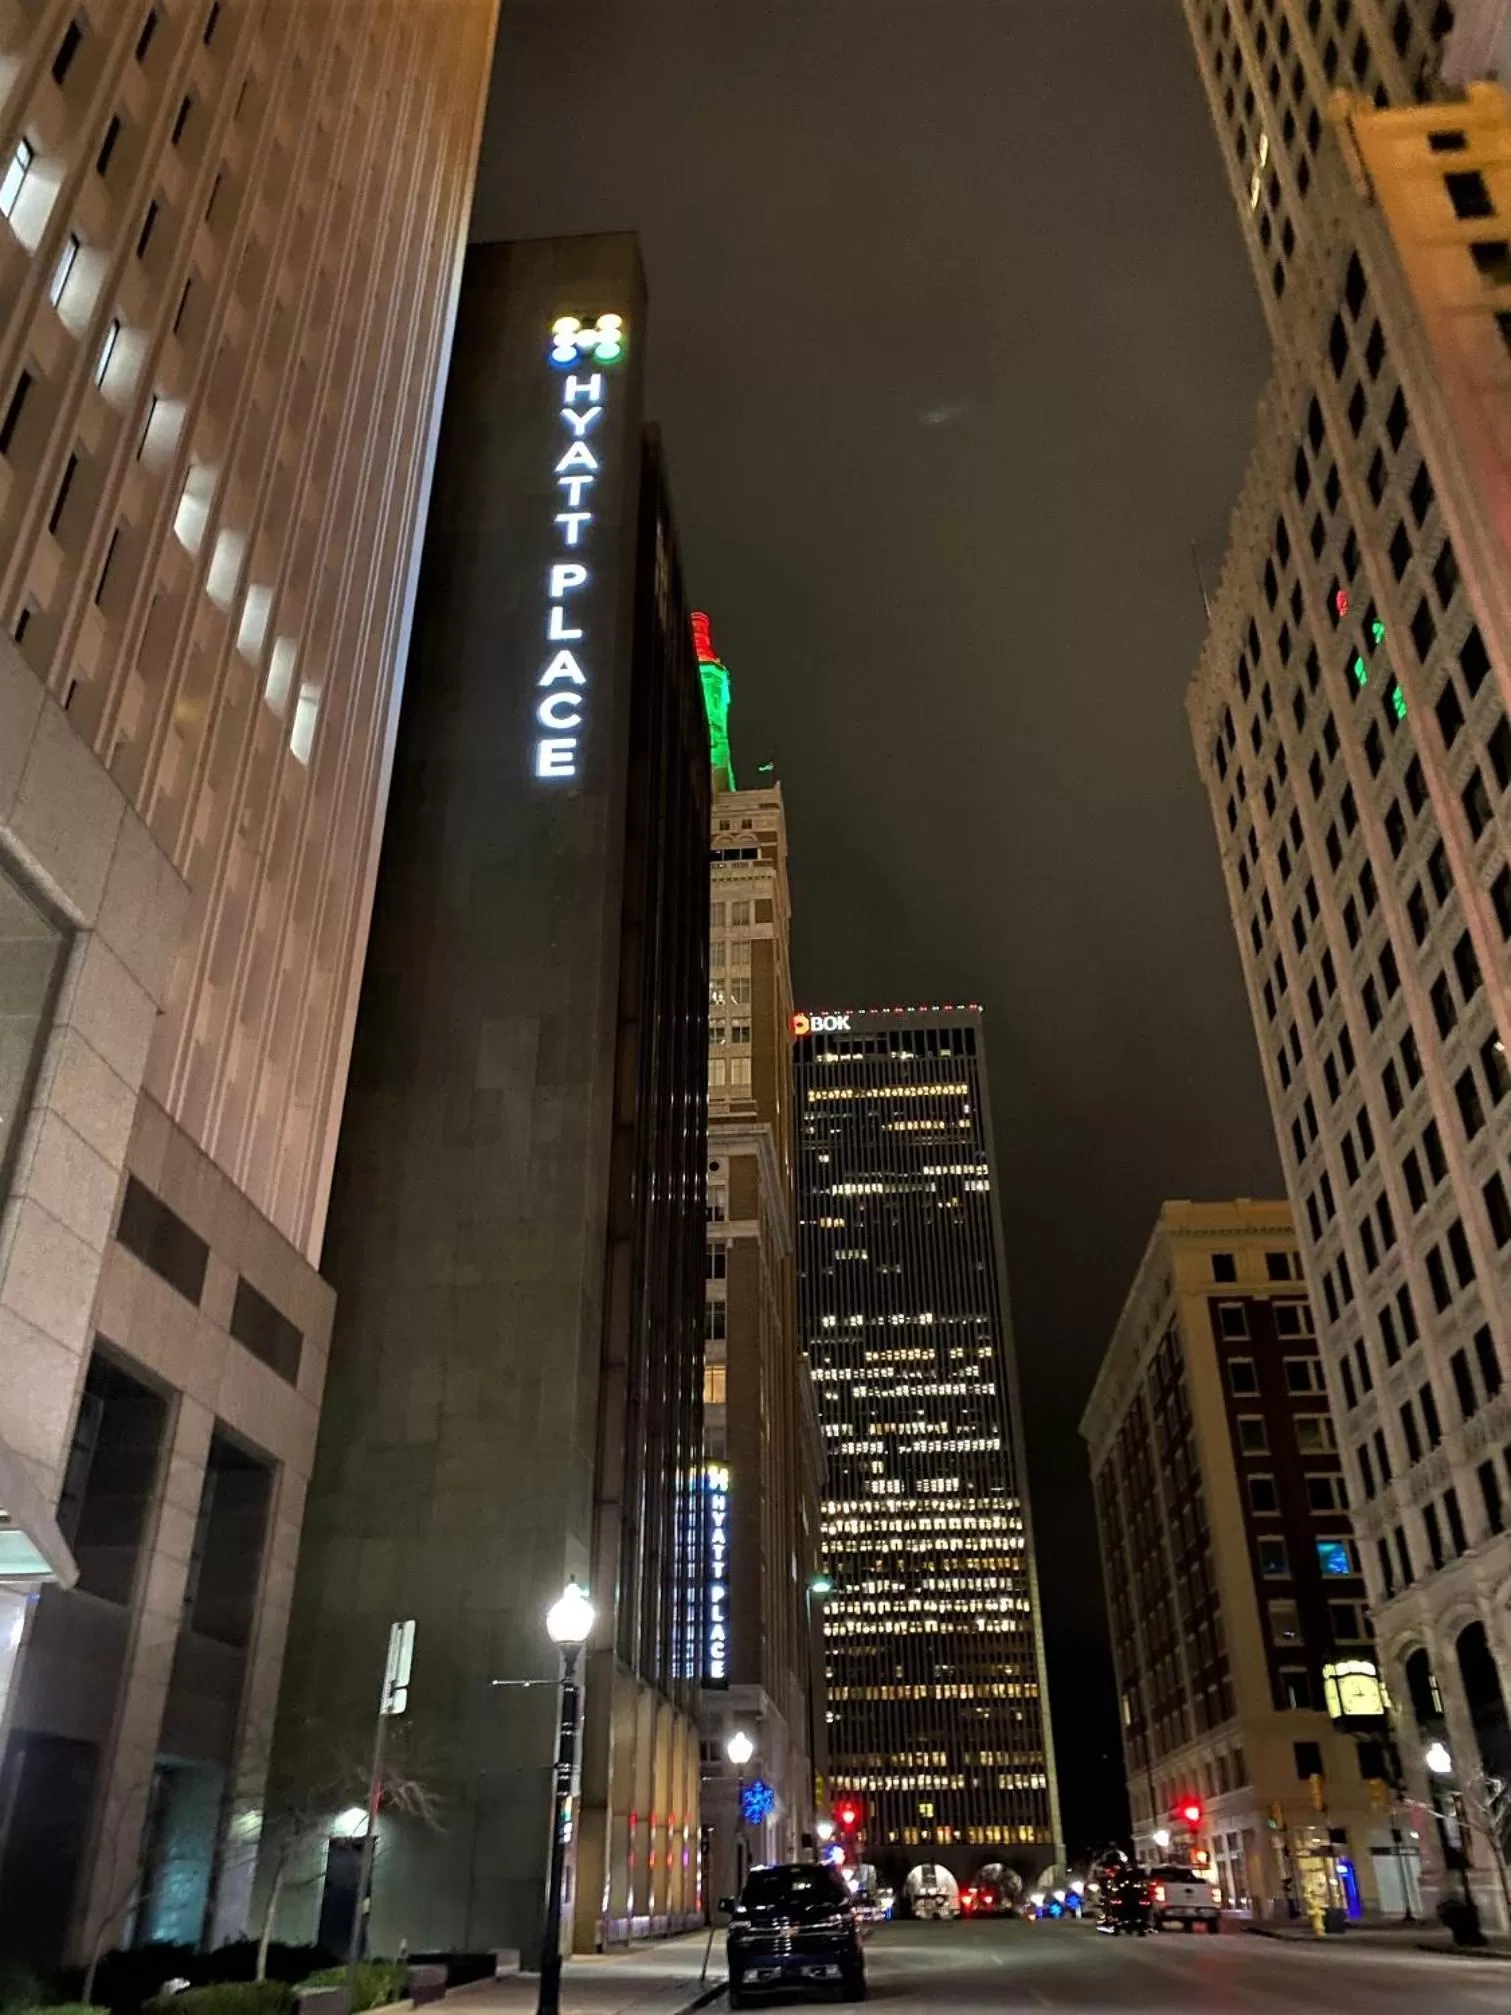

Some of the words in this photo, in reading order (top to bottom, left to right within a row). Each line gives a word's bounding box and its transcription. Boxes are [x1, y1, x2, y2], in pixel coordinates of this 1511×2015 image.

[554, 373, 602, 545] HYATT
[536, 564, 588, 777] PLACE
[810, 1015, 851, 1032] BOK
[711, 1494, 726, 1578] HYATT
[710, 1585, 726, 1678] PLACE
